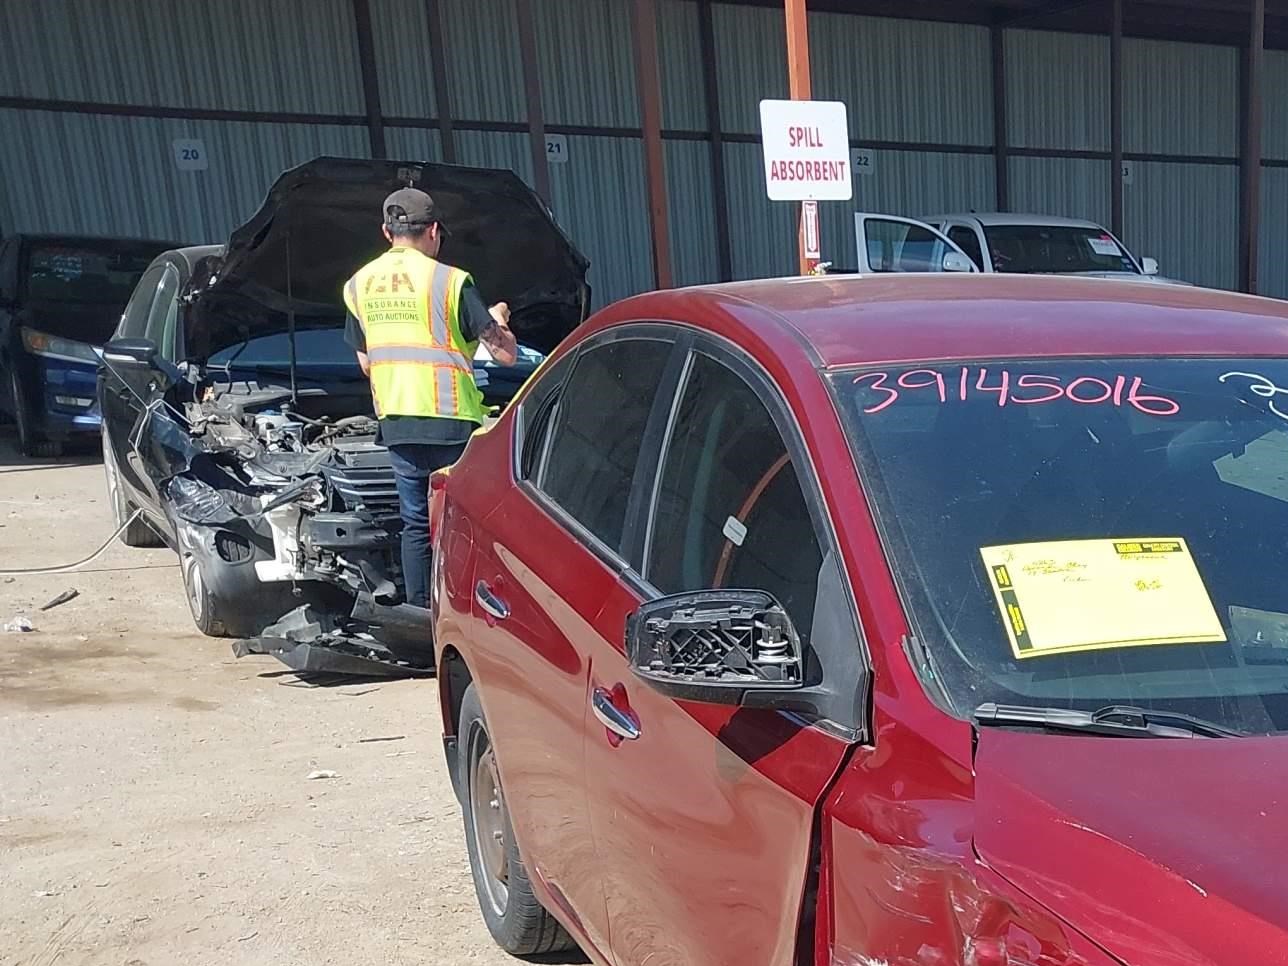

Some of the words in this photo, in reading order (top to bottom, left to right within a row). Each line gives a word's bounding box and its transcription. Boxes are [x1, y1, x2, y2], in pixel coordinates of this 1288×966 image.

[788, 126, 824, 148] SPILL
[547, 142, 561, 153] 21
[182, 149, 199, 160] 20
[856, 156, 869, 167] 22
[770, 160, 846, 181] ABSORBENT
[364, 300, 417, 310] INSURANCE
[367, 313, 384, 323] AUTO
[385, 312, 420, 322] AUCTIONS
[852, 366, 1180, 416] 39145016
